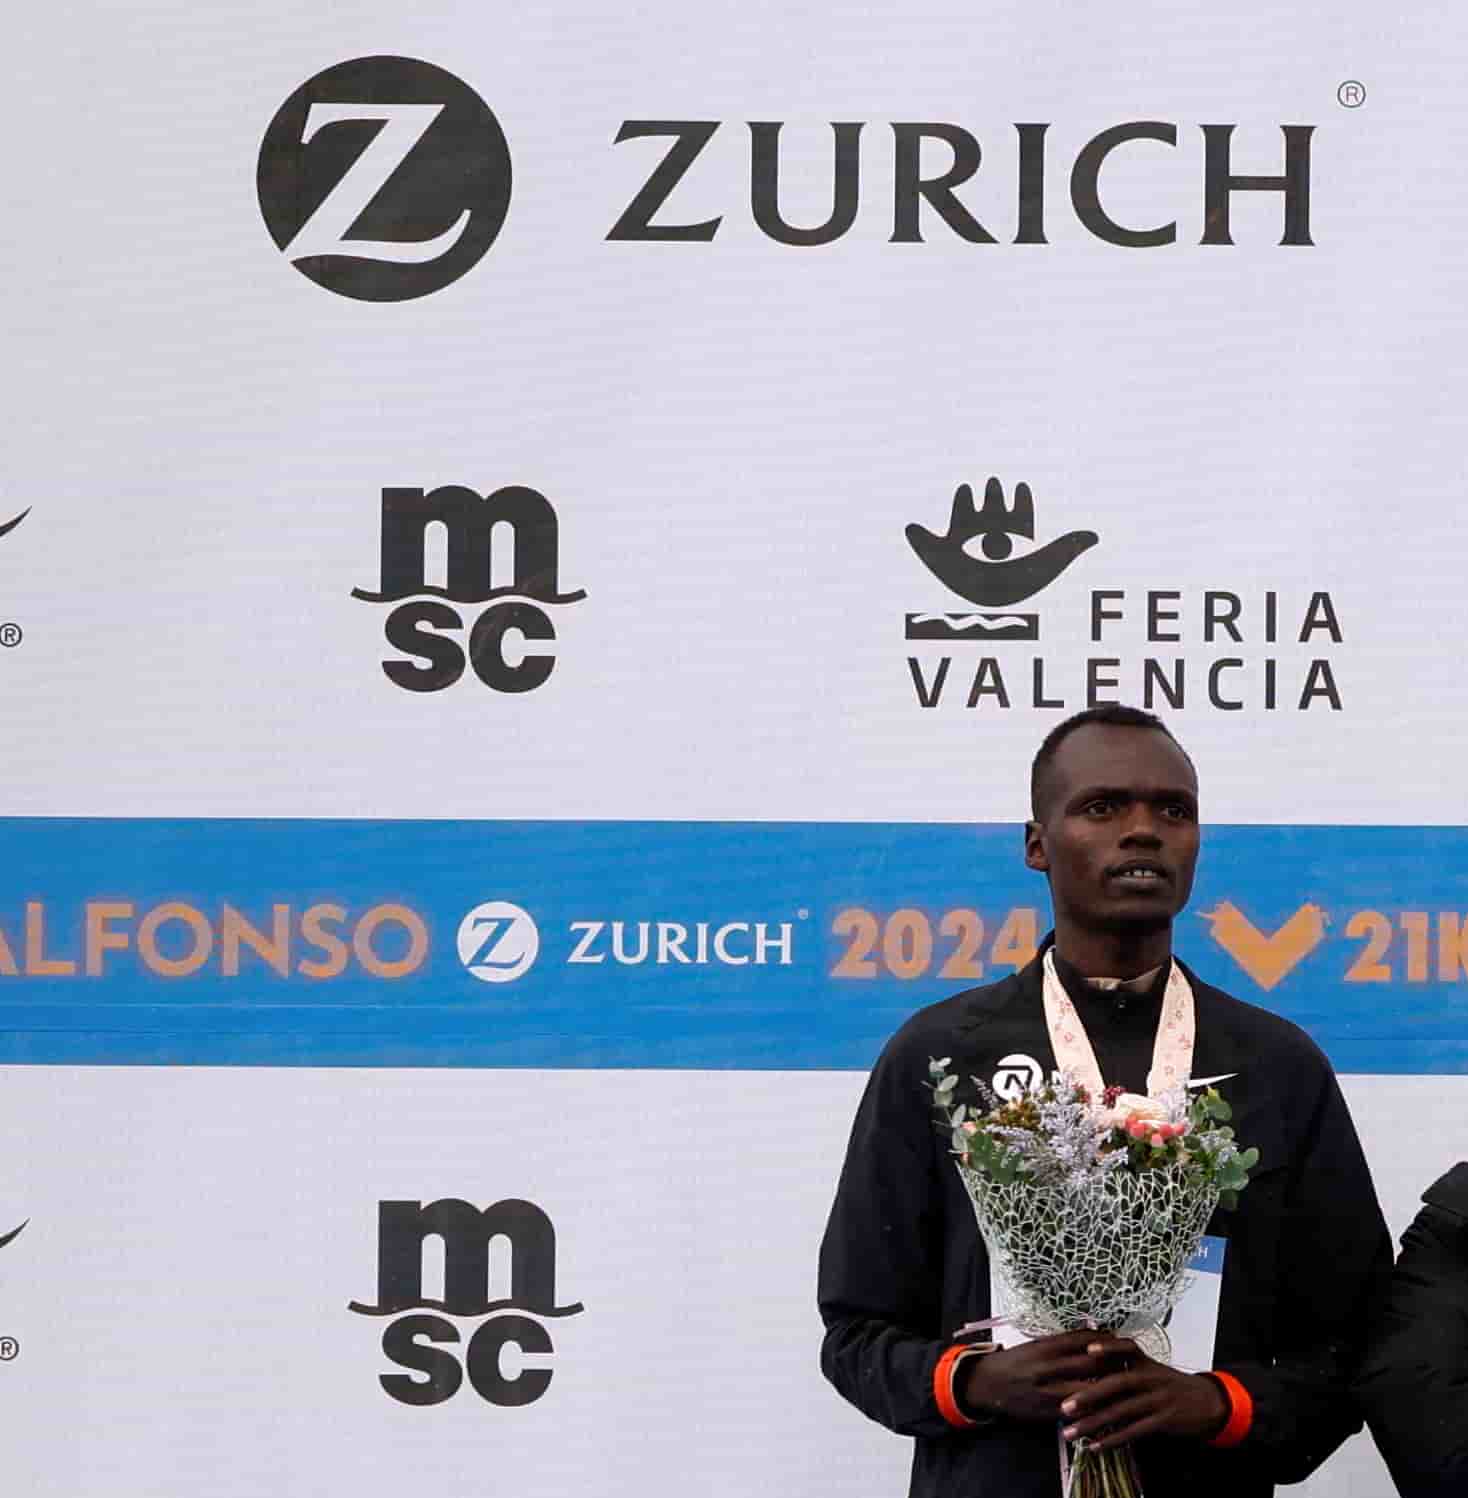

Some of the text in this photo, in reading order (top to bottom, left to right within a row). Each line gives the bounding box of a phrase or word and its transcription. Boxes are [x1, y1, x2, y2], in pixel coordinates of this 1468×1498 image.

[605, 120, 1316, 248] ZURICH
[1092, 591, 1342, 642] FERIA
[900, 652, 1350, 712] VALENCIA
[568, 922, 792, 964] ZURICH
[831, 906, 1039, 979] 2024
